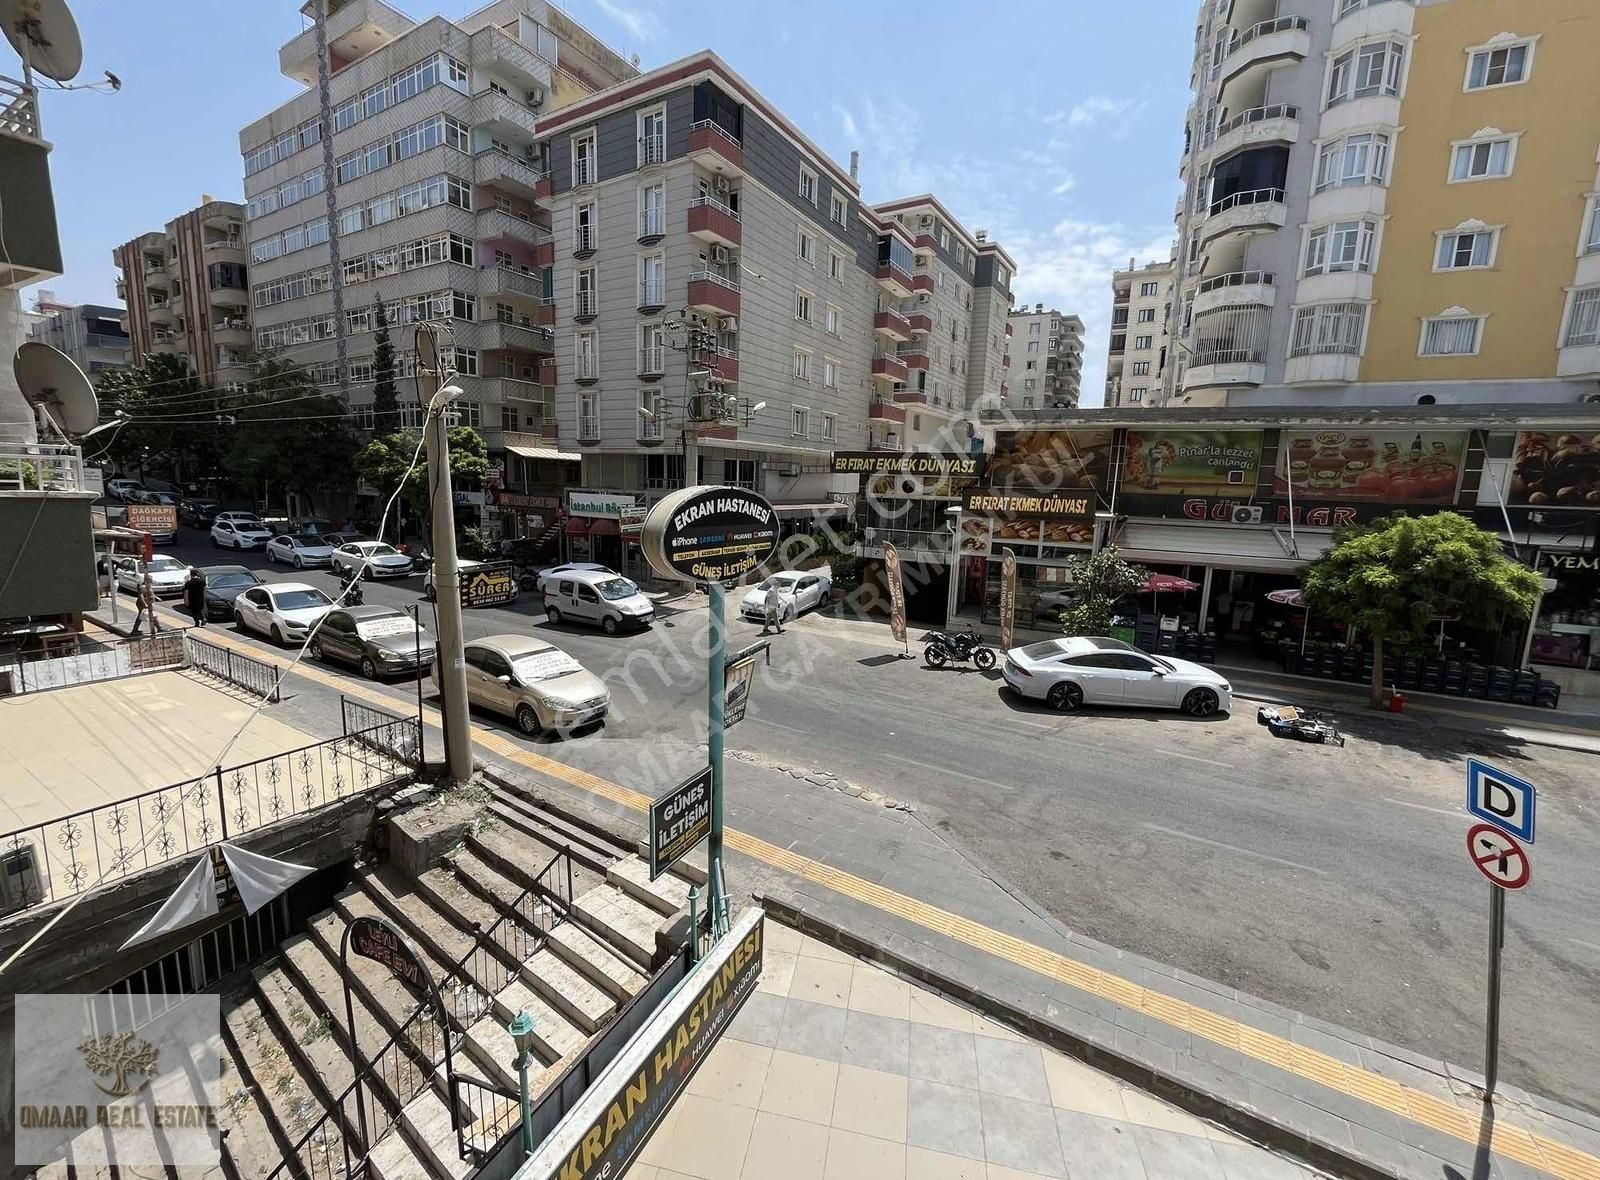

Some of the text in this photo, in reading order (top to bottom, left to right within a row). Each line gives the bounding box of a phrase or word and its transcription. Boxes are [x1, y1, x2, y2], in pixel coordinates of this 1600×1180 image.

[835, 456, 976, 473] ER FIRAT EKMEK DÜNYASI
[1223, 446, 1254, 458] lezzet
[674, 498, 771, 532] EKRAN HASTANESİ
[969, 494, 1088, 514] ER FIRAT EKMEK DÜNYASI
[677, 536, 698, 546] iPhone
[691, 555, 757, 579] GÜNEŞ İLETİŞİM
[469, 581, 510, 597] SÜRER
[664, 783, 704, 820] GÜNEŞ
[1484, 777, 1516, 818] D
[658, 800, 708, 848] İLETİŞİM
[692, 1008, 724, 1060] HUAWEI
[734, 960, 760, 997] xiaomi
[557, 922, 760, 1180] KRAN HASTANESİ
